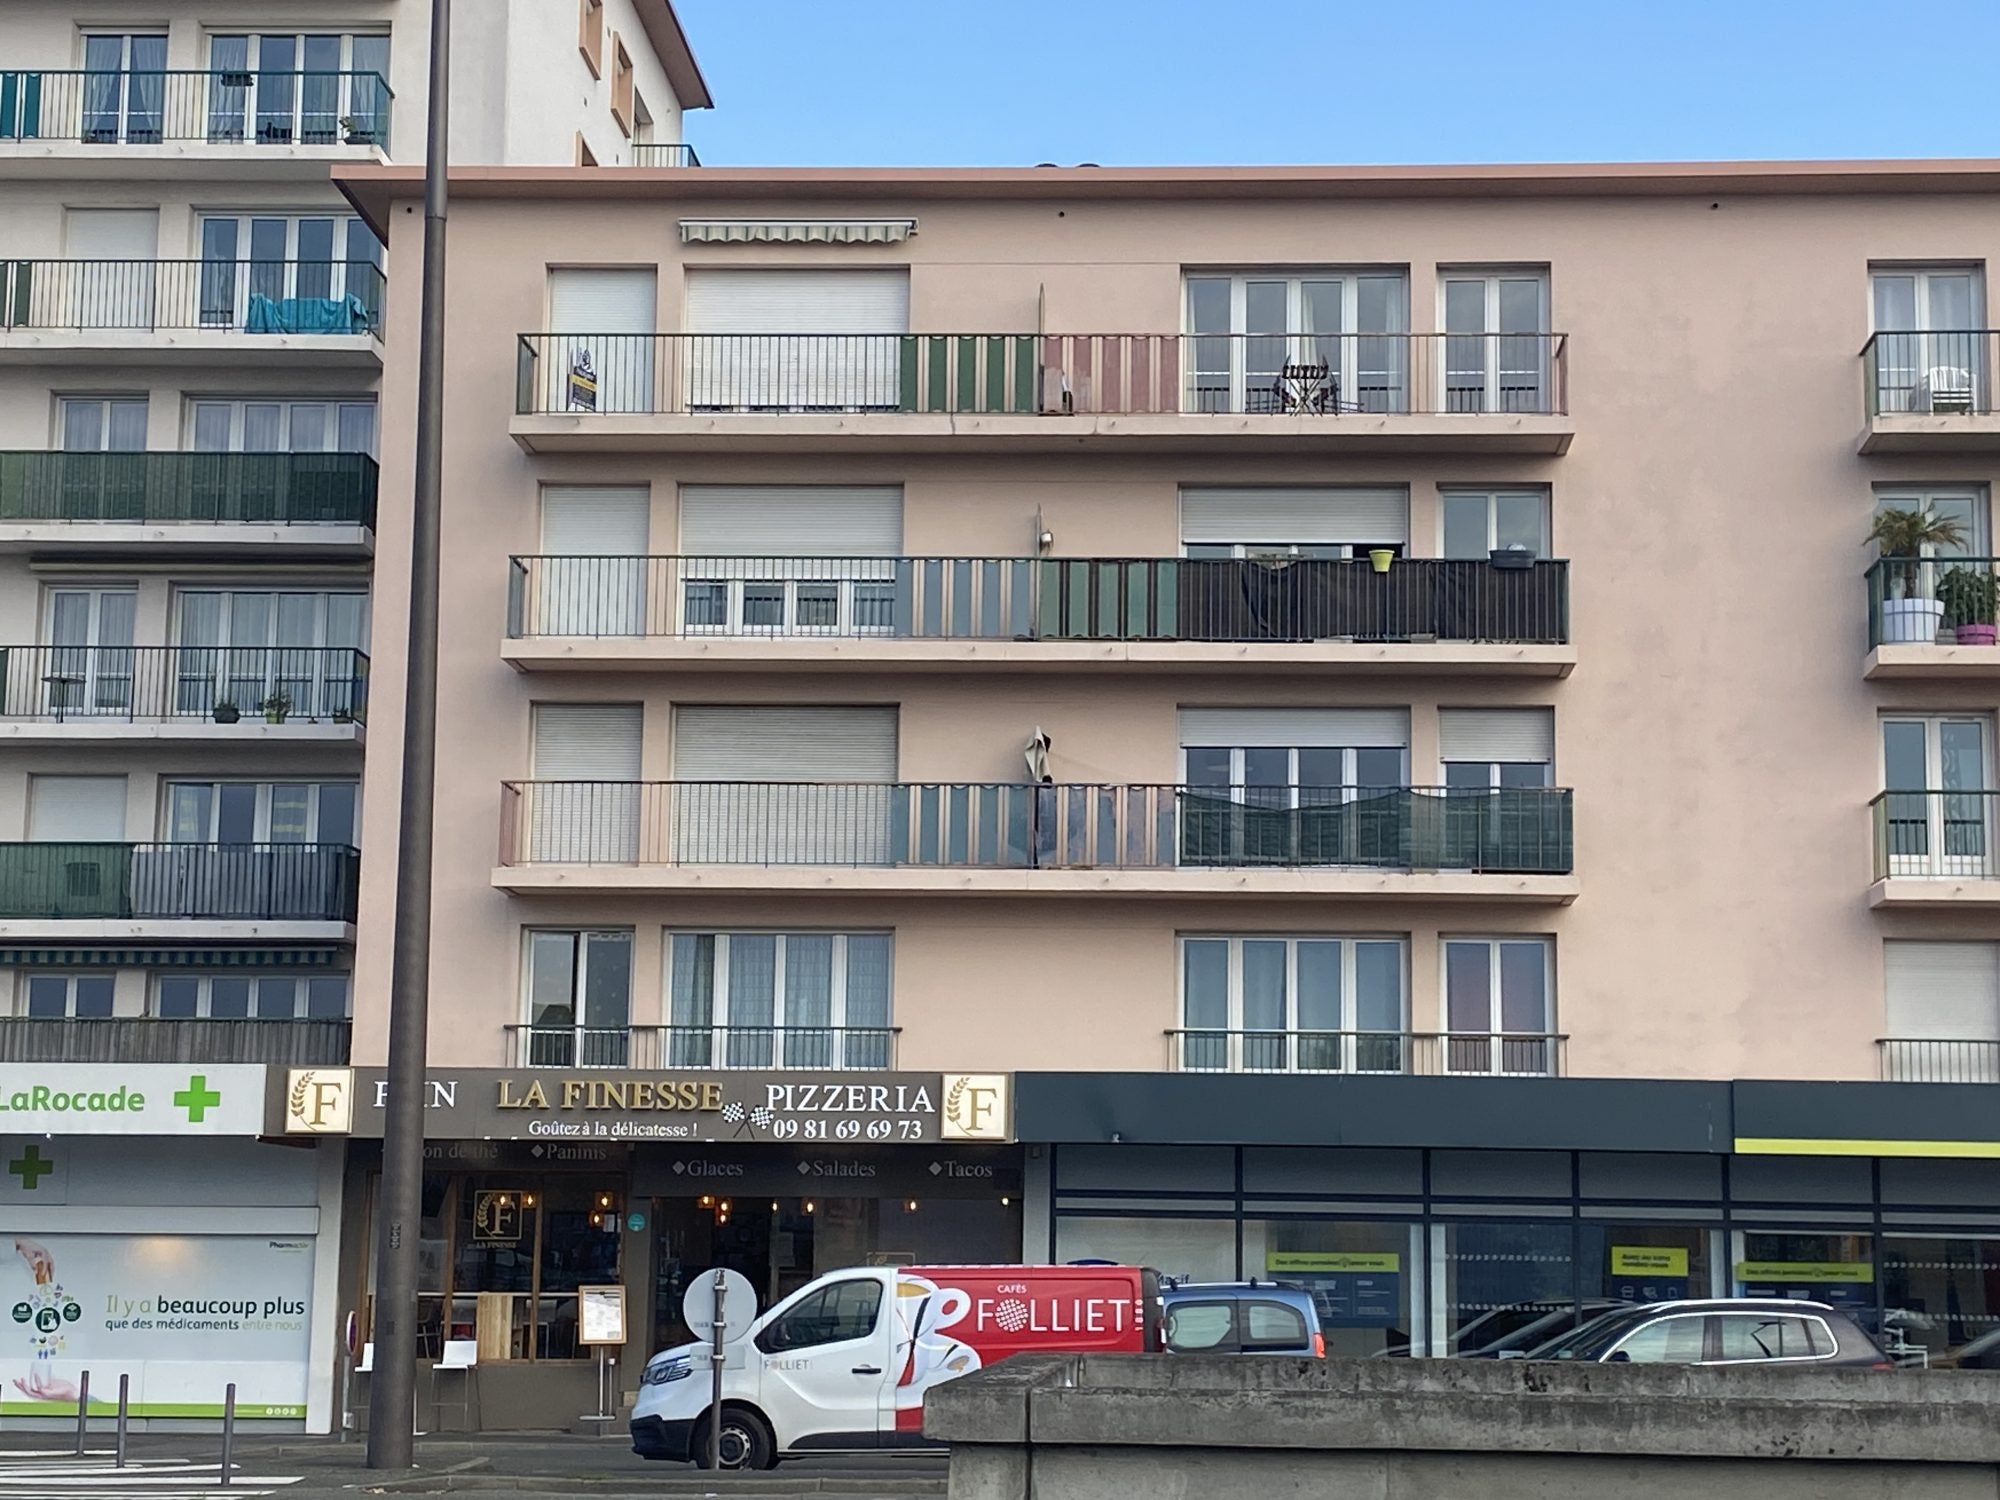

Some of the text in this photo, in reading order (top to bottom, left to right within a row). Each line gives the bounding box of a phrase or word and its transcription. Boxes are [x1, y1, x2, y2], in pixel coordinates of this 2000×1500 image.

[309, 1082, 342, 1125] F
[373, 1081, 458, 1108] PN
[497, 1079, 723, 1111] LA FINESSE
[765, 1084, 936, 1113] PIZZERIA
[968, 1088, 998, 1131] F
[528, 1120, 580, 1136] Goûtez
[582, 1121, 590, 1136] à
[595, 1121, 608, 1136] la
[611, 1122, 689, 1137] délicatesse
[773, 1119, 922, 1139] 09 81 69 69 73
[687, 1160, 744, 1177] Glaces
[812, 1160, 877, 1177] Salades
[944, 1161, 993, 1178] Tacos
[997, 1283, 1027, 1294] CAFÉS
[124, 1300, 134, 1318] y
[157, 1295, 257, 1319] beaucoup
[263, 1296, 305, 1319] plus
[977, 1299, 1130, 1332] FOLLIET
[105, 1318, 129, 1331] que
[131, 1318, 153, 1329] des
[156, 1318, 239, 1330] médicaments
